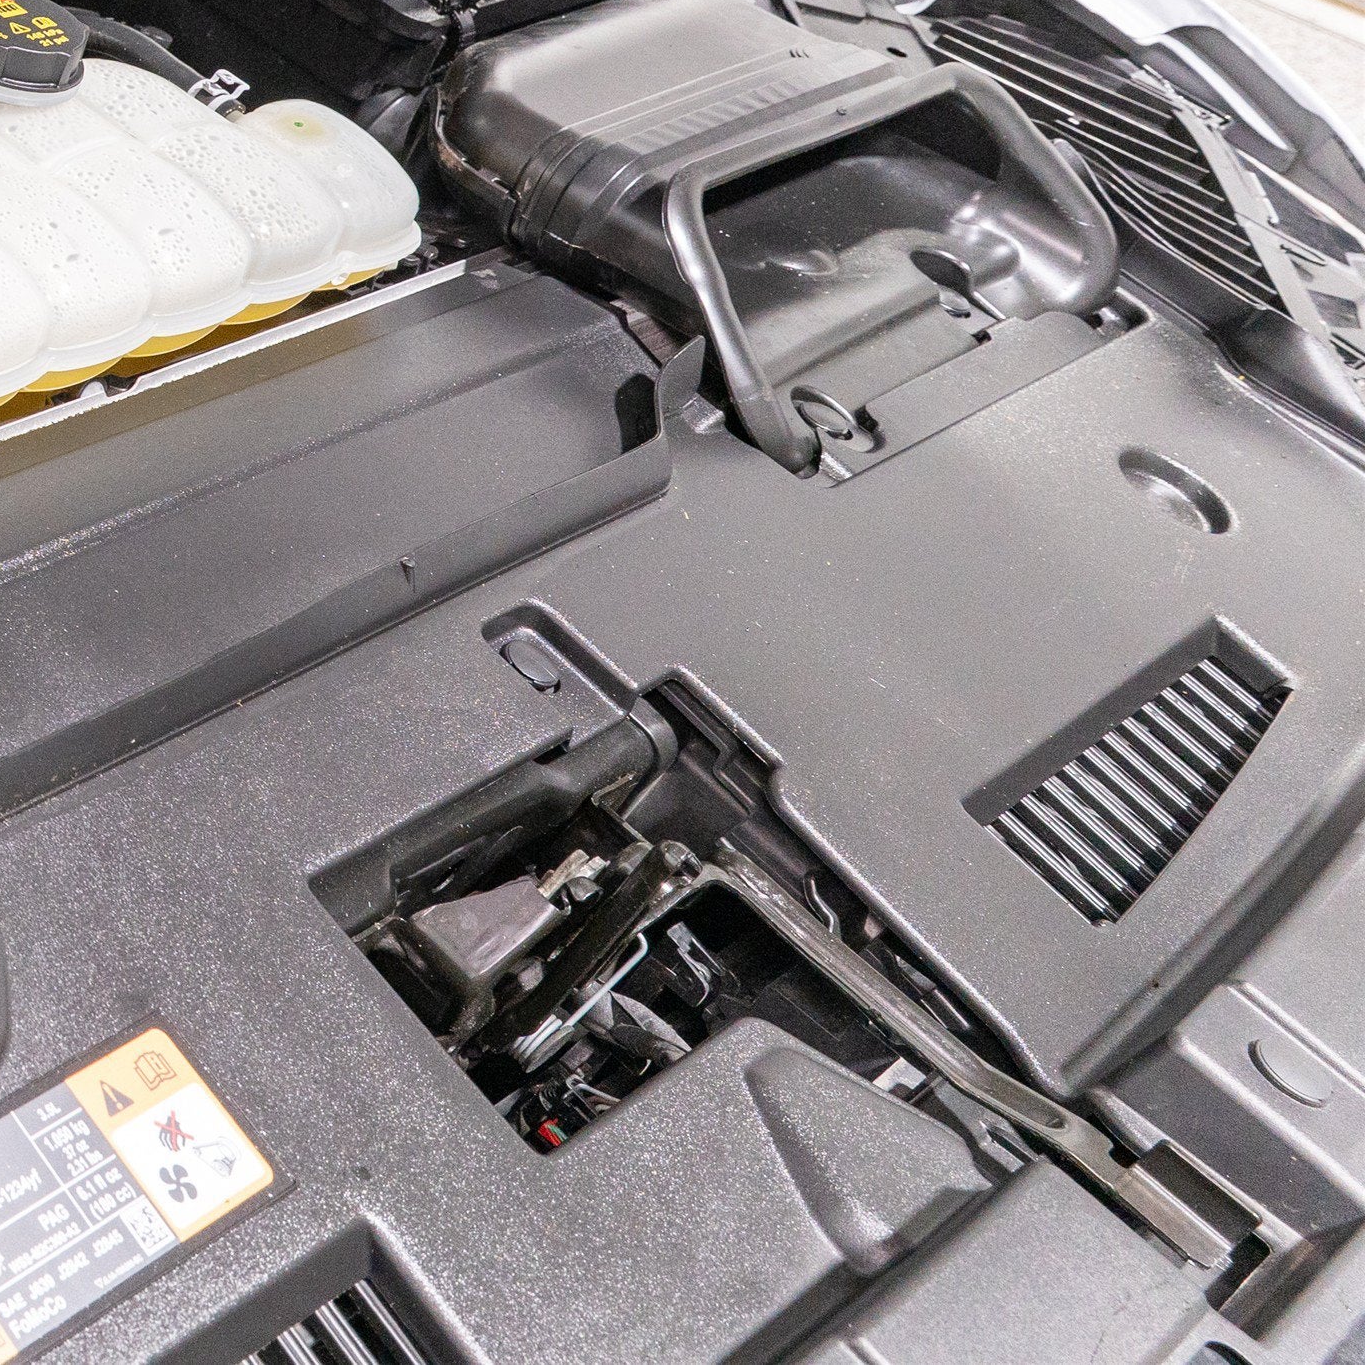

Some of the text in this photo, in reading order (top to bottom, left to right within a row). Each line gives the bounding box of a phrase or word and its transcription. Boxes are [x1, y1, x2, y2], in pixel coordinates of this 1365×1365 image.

[69, 1118, 90, 1136] kg
[61, 1138, 90, 1160] 37 oz
[104, 1167, 123, 1183] oz
[36, 1202, 70, 1232] PAG
[7, 1294, 67, 1340] FoMoCo
